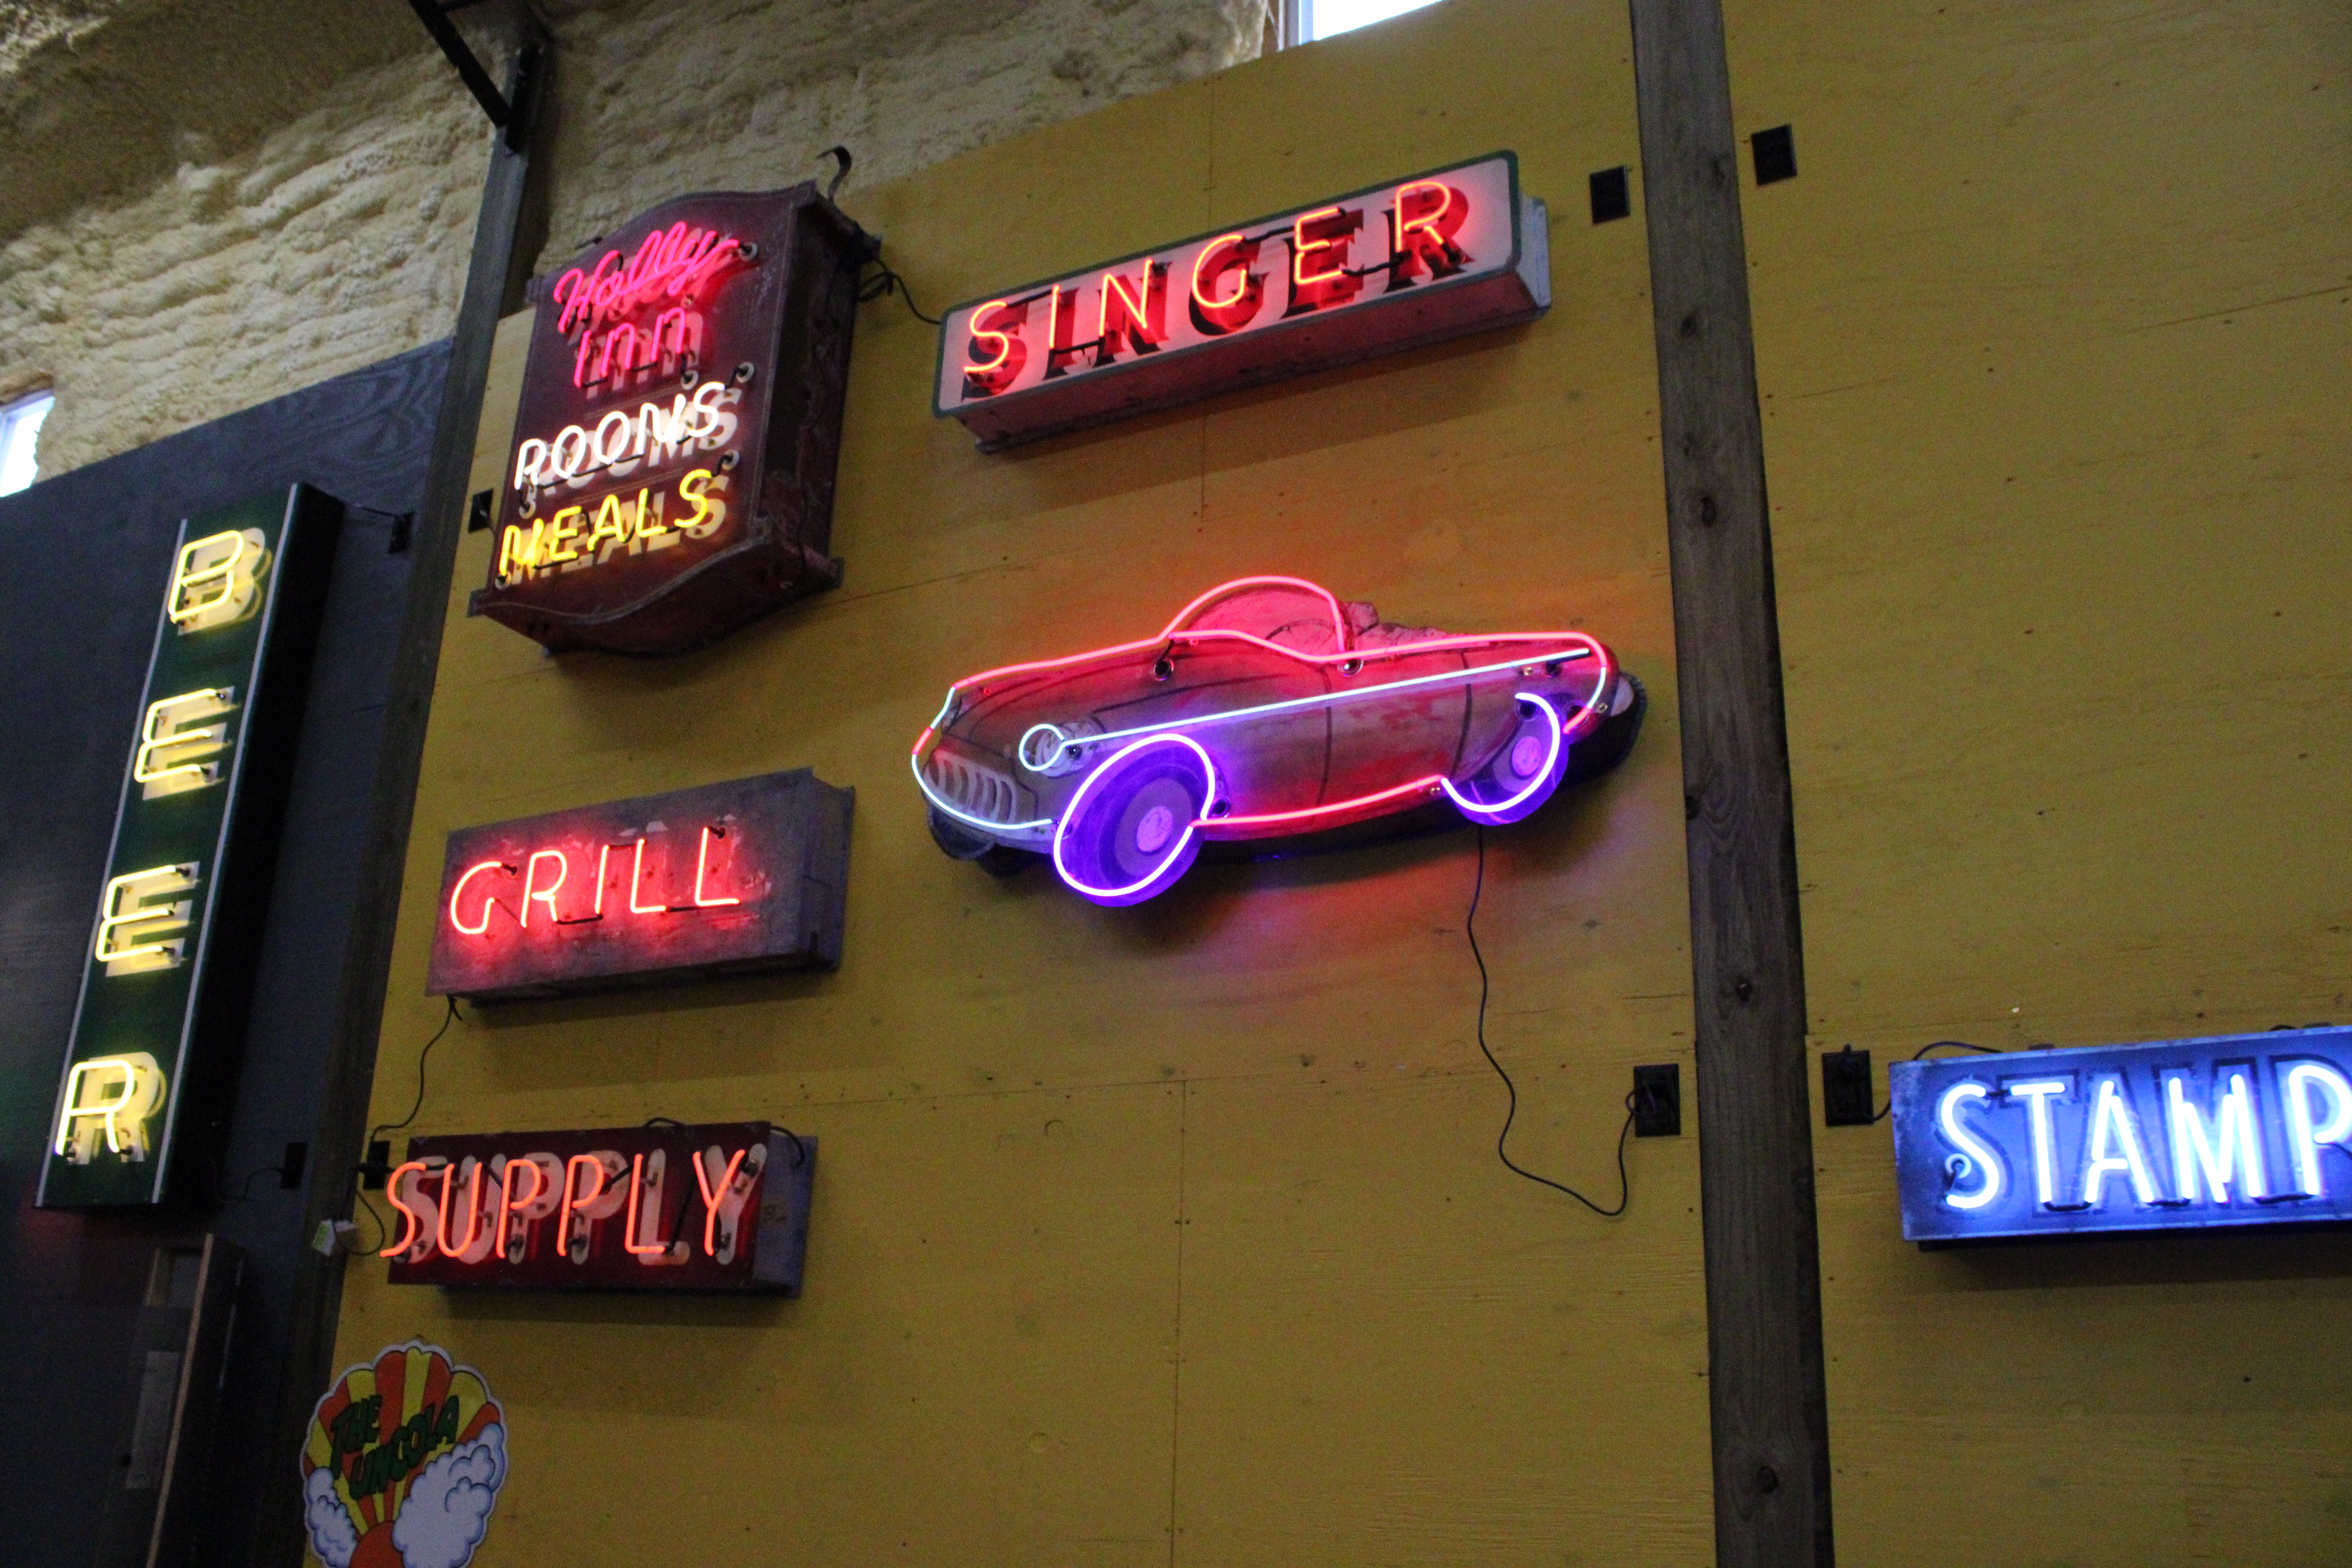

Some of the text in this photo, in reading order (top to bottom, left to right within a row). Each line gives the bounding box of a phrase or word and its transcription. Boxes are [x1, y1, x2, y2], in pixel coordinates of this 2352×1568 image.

[553, 220, 740, 333] Holly
[960, 180, 1470, 398] SINGER
[514, 381, 739, 496] ROOMS
[499, 468, 727, 584] MEALS
[54, 527, 267, 1164] BEER
[450, 824, 742, 935] GRILL
[1936, 1058, 2352, 1211] STAMP
[379, 1145, 765, 1264] SUPPLY
[330, 1395, 382, 1480] THE
[348, 1394, 459, 1501] UNCOLA
